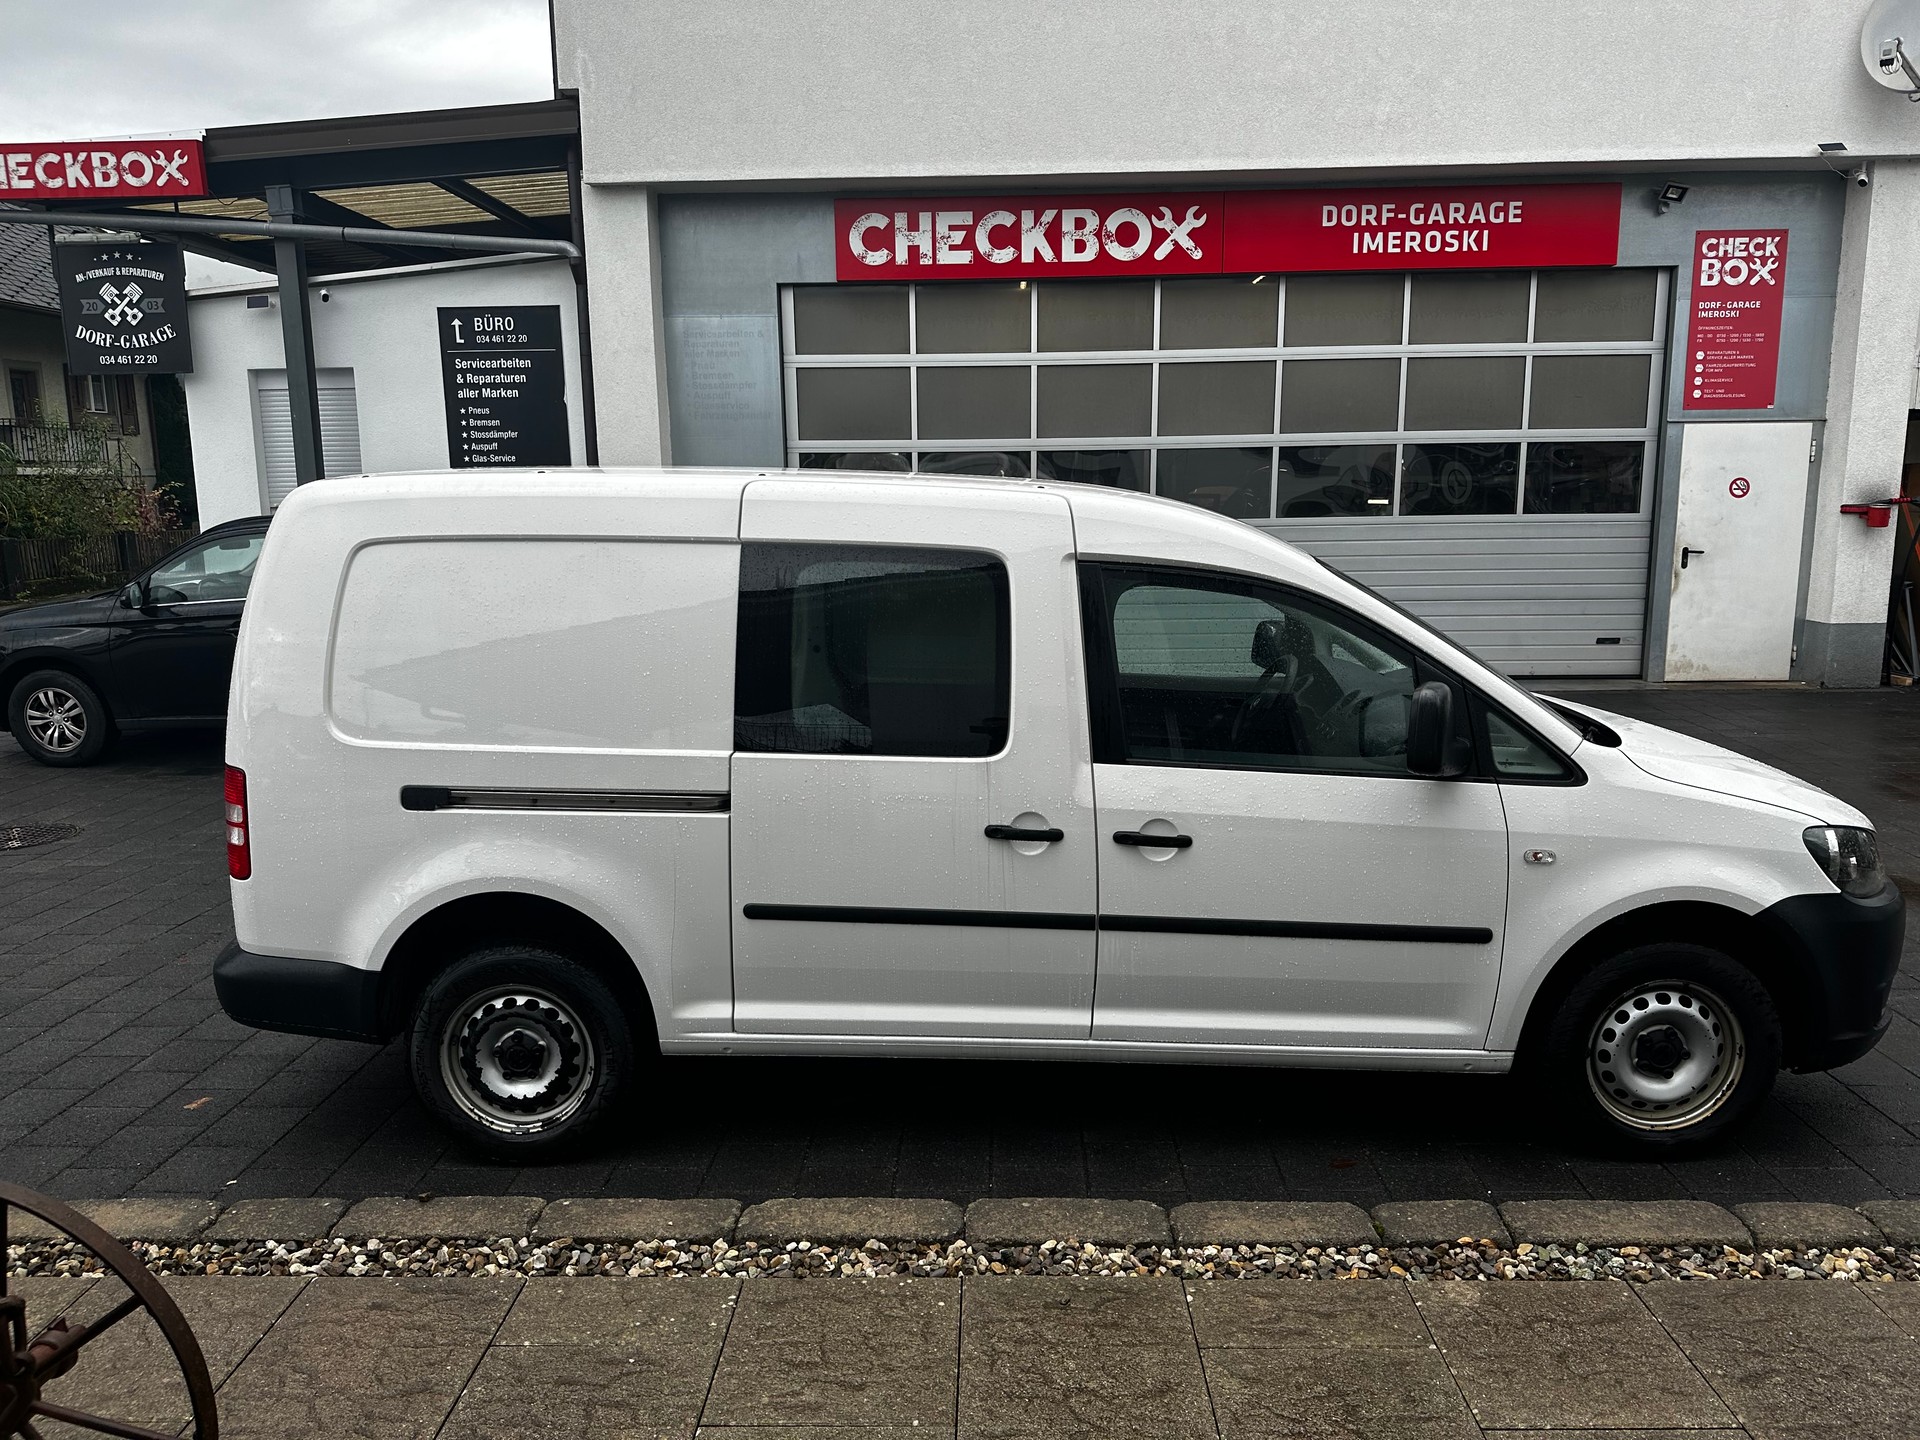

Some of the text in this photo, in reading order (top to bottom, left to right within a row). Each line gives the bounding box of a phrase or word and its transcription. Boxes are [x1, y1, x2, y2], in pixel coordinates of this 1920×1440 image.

[0, 149, 189, 190] ECKBOX
[1322, 201, 1523, 227] DORF-GARAGE
[849, 206, 1207, 265] CHECKBOX
[1353, 230, 1489, 254] IMEROSKI
[1702, 236, 1781, 258] CHECK
[75, 267, 164, 283] AN-/VERKAUF & REPARATUREN
[1700, 257, 1779, 286] BOX
[86, 301, 159, 311] 20 03
[1698, 310, 1740, 318] IMEROSKI
[474, 314, 514, 331] BÜRO
[75, 323, 177, 349] DORF-GARAGE
[476, 335, 489, 343] 034
[518, 334, 528, 342] 20
[100, 354, 158, 364] 034 461 22 20
[455, 357, 531, 369] Servicearbeiten
[456, 373, 526, 385] & Reparaturen
[457, 387, 519, 398] aller Marken
[468, 407, 490, 415] Pneus
[469, 419, 500, 427] Bremsen
[470, 430, 518, 440] Stossdämpfer
[471, 442, 498, 452] Auspuff
[472, 454, 516, 462] Glas-Service
